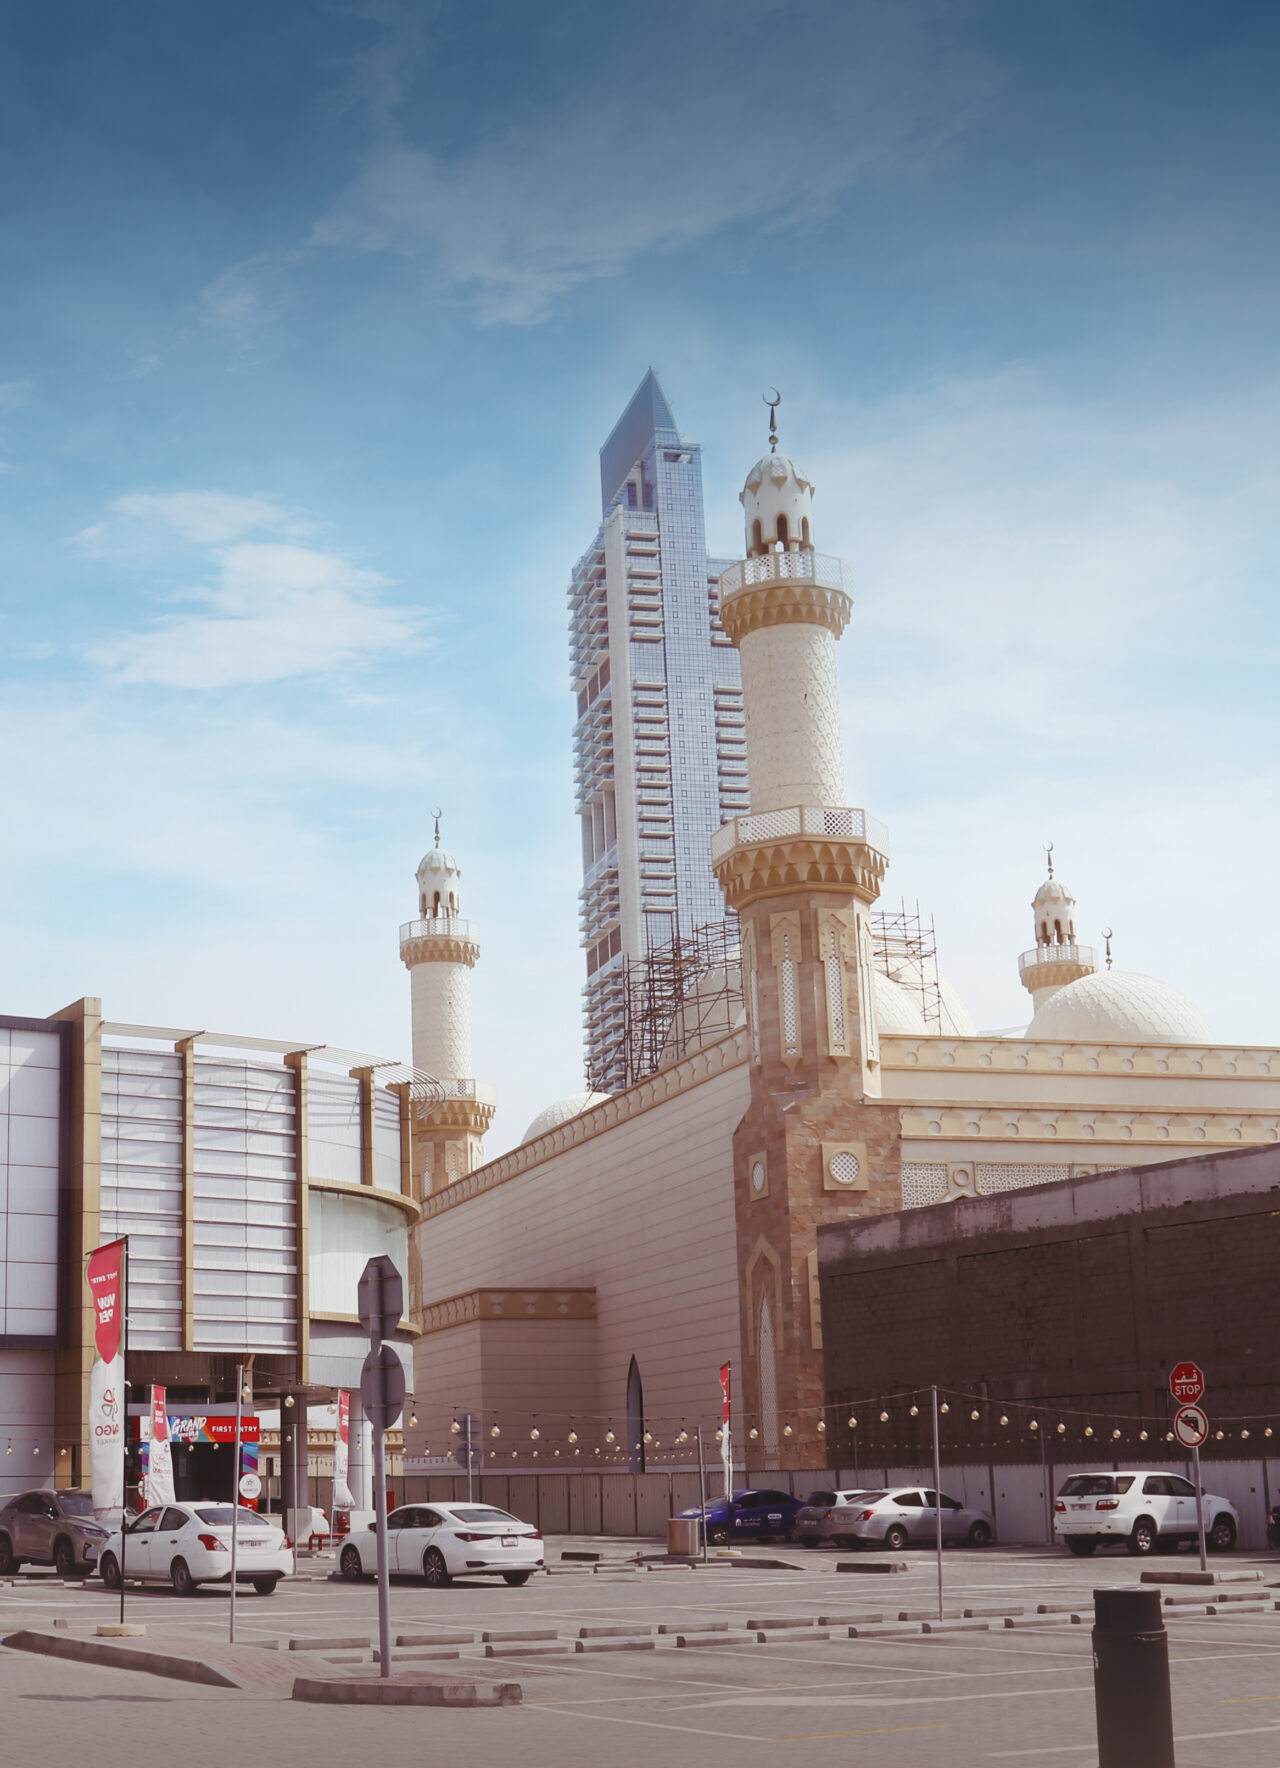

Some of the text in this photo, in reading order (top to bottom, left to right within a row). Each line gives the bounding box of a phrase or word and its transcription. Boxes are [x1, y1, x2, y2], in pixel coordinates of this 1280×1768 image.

[1175, 1369, 1198, 1383] قف
[1175, 1384, 1201, 1396] STOP
[172, 1416, 207, 1434] GRAND
[212, 1425, 232, 1433] FIRST
